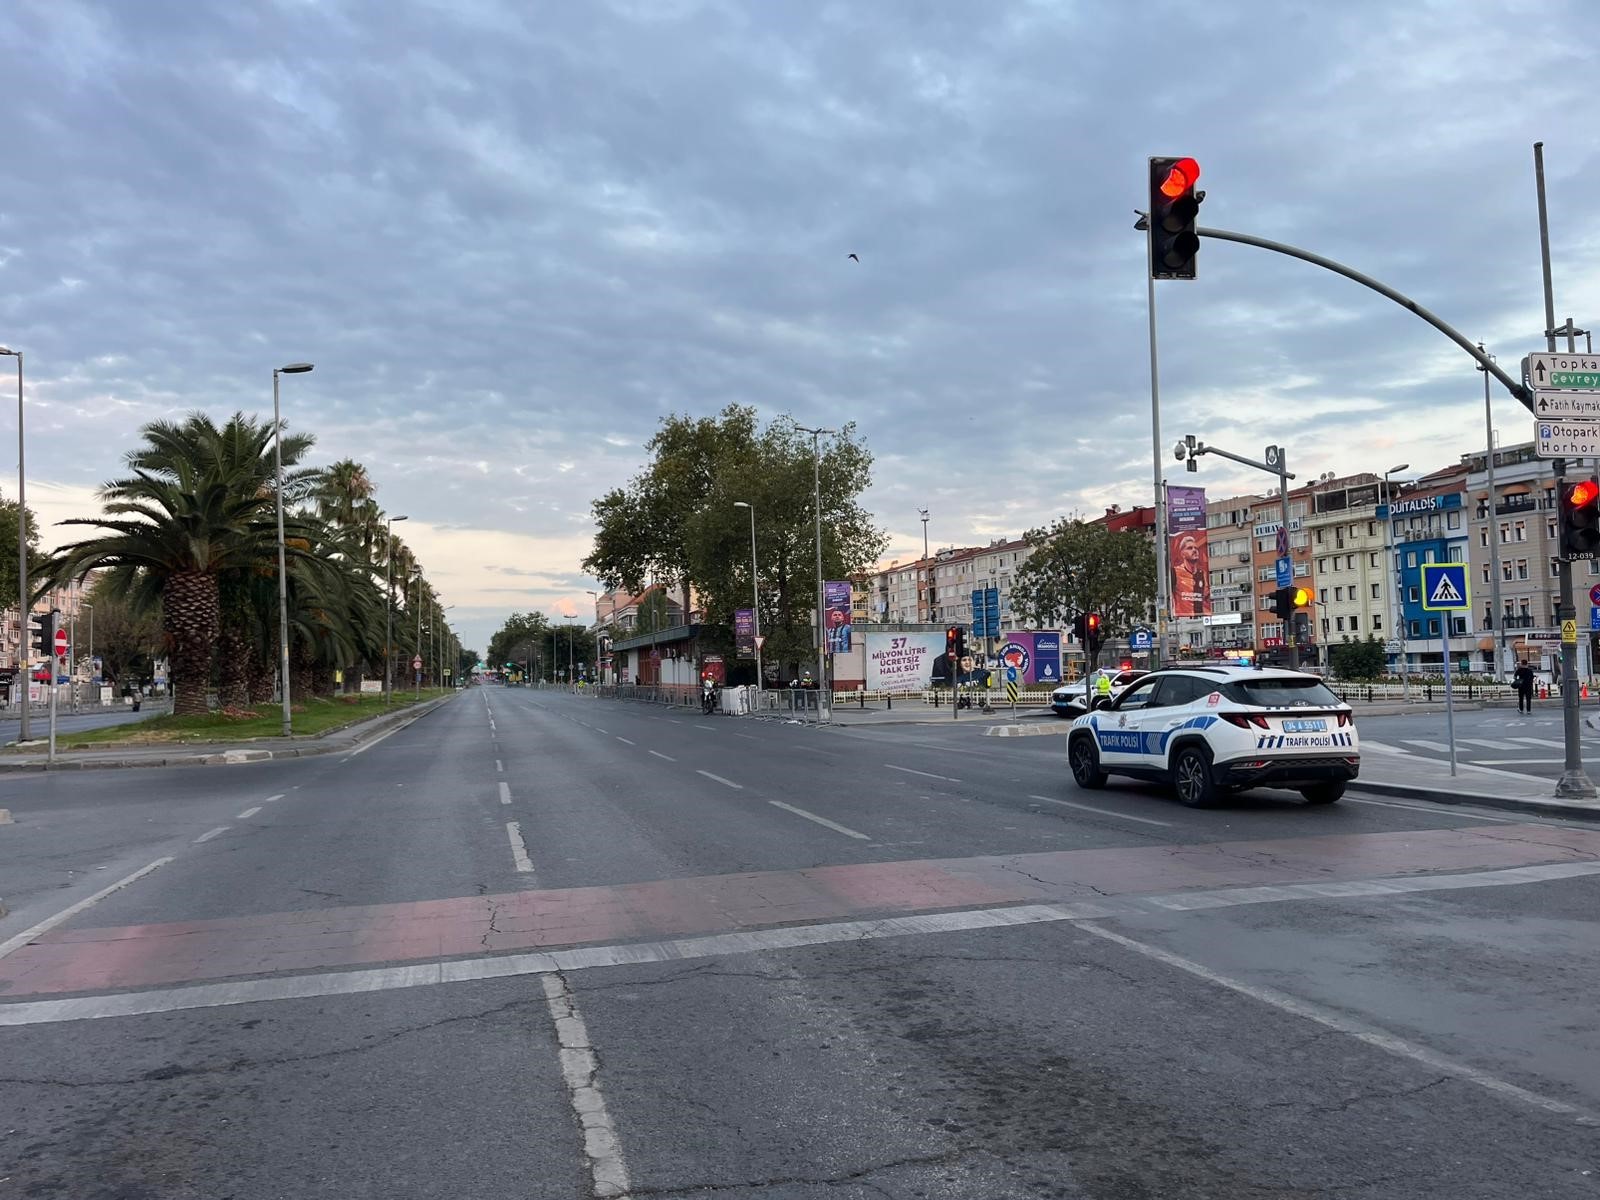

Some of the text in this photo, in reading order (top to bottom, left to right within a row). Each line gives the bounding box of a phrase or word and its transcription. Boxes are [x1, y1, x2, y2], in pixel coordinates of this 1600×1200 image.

[1550, 357, 1598, 371] Topka
[1551, 372, 1598, 387] Çevrey
[1550, 399, 1569, 410] Fatih
[1552, 425, 1599, 440] Otopark
[1541, 441, 1596, 452] Horhor
[1568, 552, 1594, 560] 12-039
[891, 637, 908, 650] 37
[872, 646, 927, 660] MİLYON LİTRE
[880, 655, 920, 667] ÜCRETSİZ
[880, 662, 920, 675] HALK SÜT
[1286, 721, 1296, 730] 34
[1298, 721, 1303, 730] A
[1100, 734, 1139, 748] TRAFİK POLİSİ
[1286, 735, 1331, 747] TRAFİK POLİSİ
